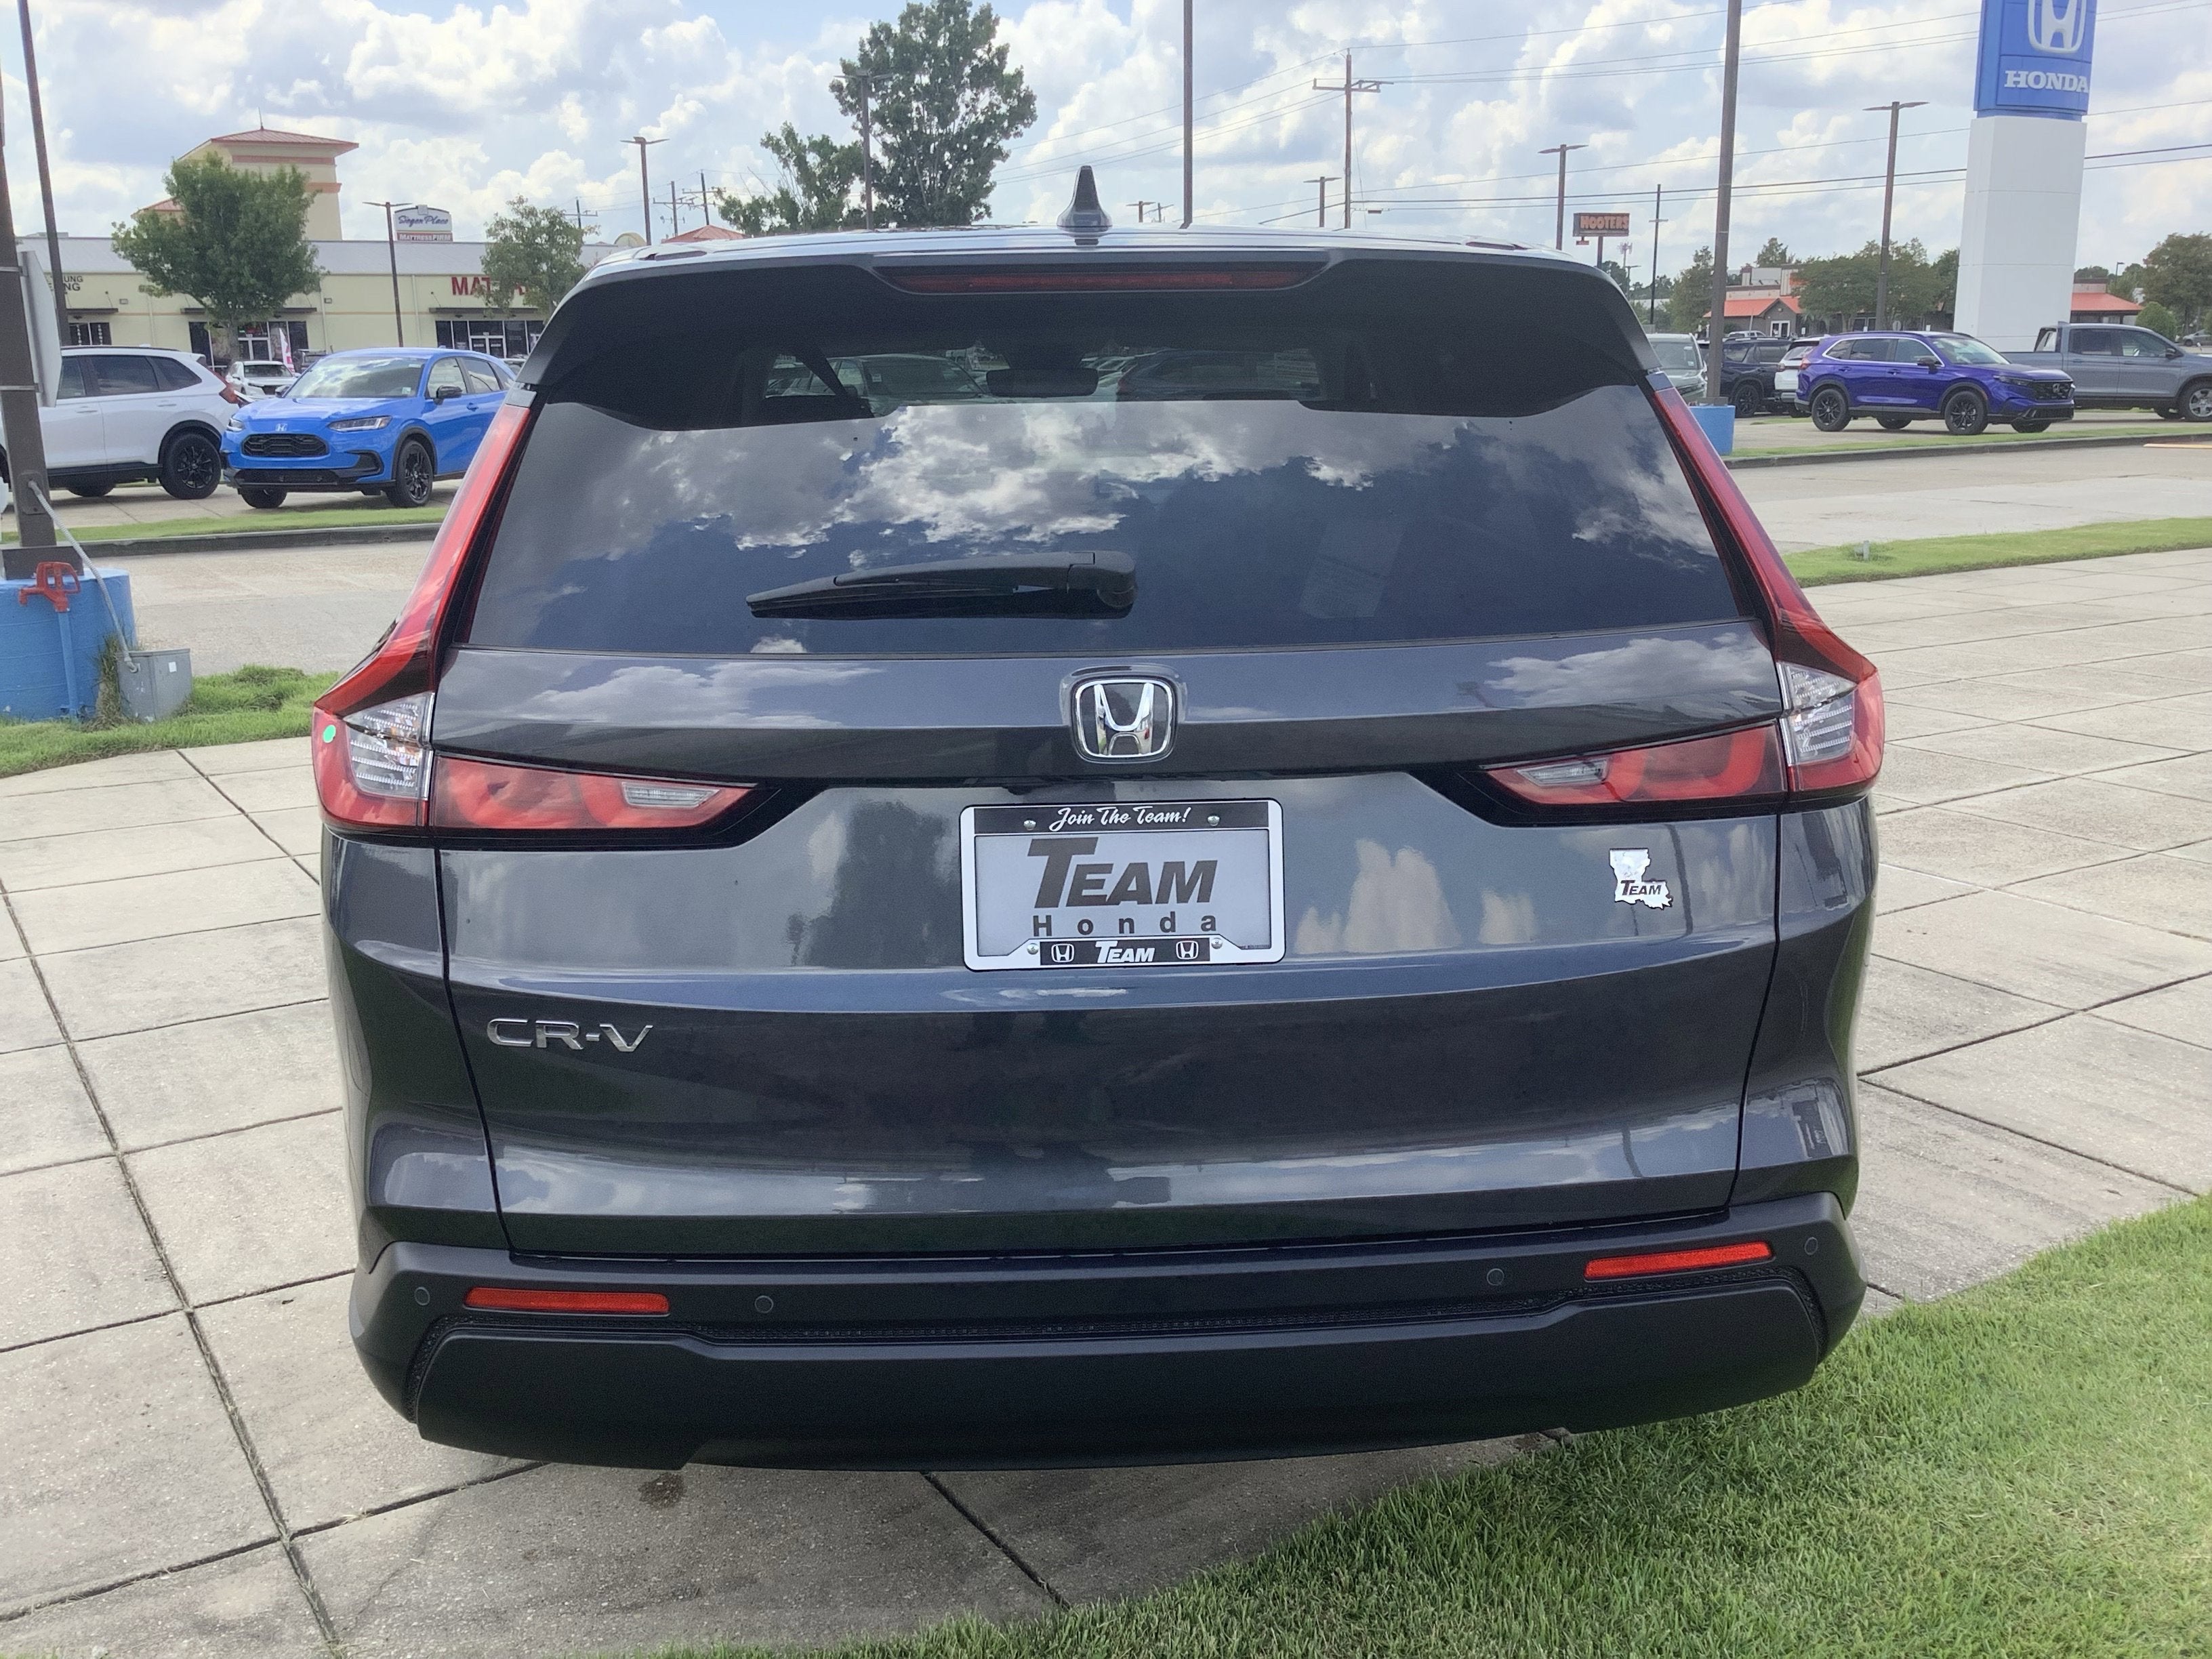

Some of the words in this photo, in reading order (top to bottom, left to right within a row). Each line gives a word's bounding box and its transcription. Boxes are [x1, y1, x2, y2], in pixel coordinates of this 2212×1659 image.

[2004, 70, 2089, 94] HONDA
[1580, 216, 1629, 230] HOOTERS
[1049, 807, 1094, 832] Join
[1096, 806, 1131, 825] The
[1132, 806, 1191, 824] Team!
[487, 1018, 653, 1052] CR-V
